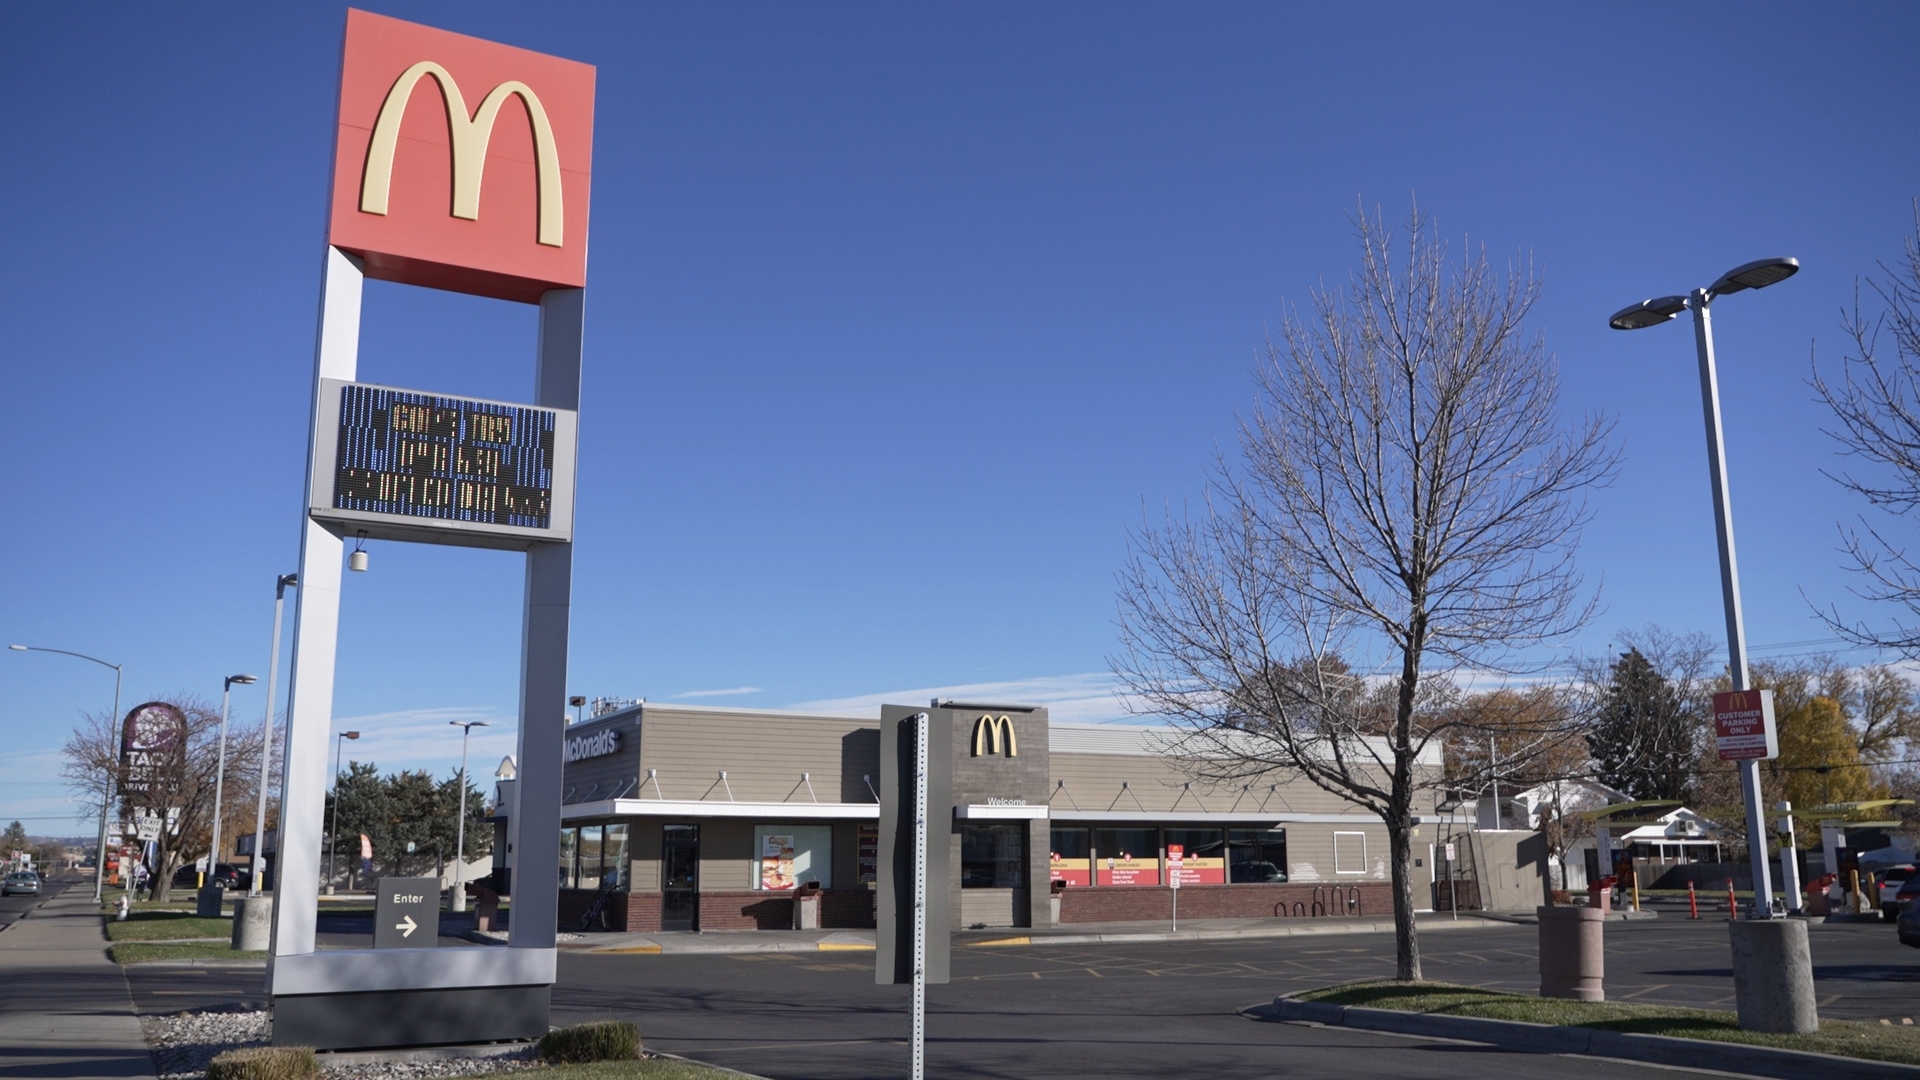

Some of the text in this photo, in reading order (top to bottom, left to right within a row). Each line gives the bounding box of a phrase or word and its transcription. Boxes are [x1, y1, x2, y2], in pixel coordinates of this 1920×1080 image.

[1717, 709, 1761, 720] CUSTOMER
[1722, 718, 1758, 727] PARKING
[1730, 726, 1752, 735] ONLY
[564, 728, 615, 762] McDonald's
[126, 751, 178, 766] TAC
[987, 797, 1027, 806] Welcome
[144, 818, 161, 826] EXIT
[141, 825, 160, 833] ONLY
[393, 893, 424, 904] Enter
